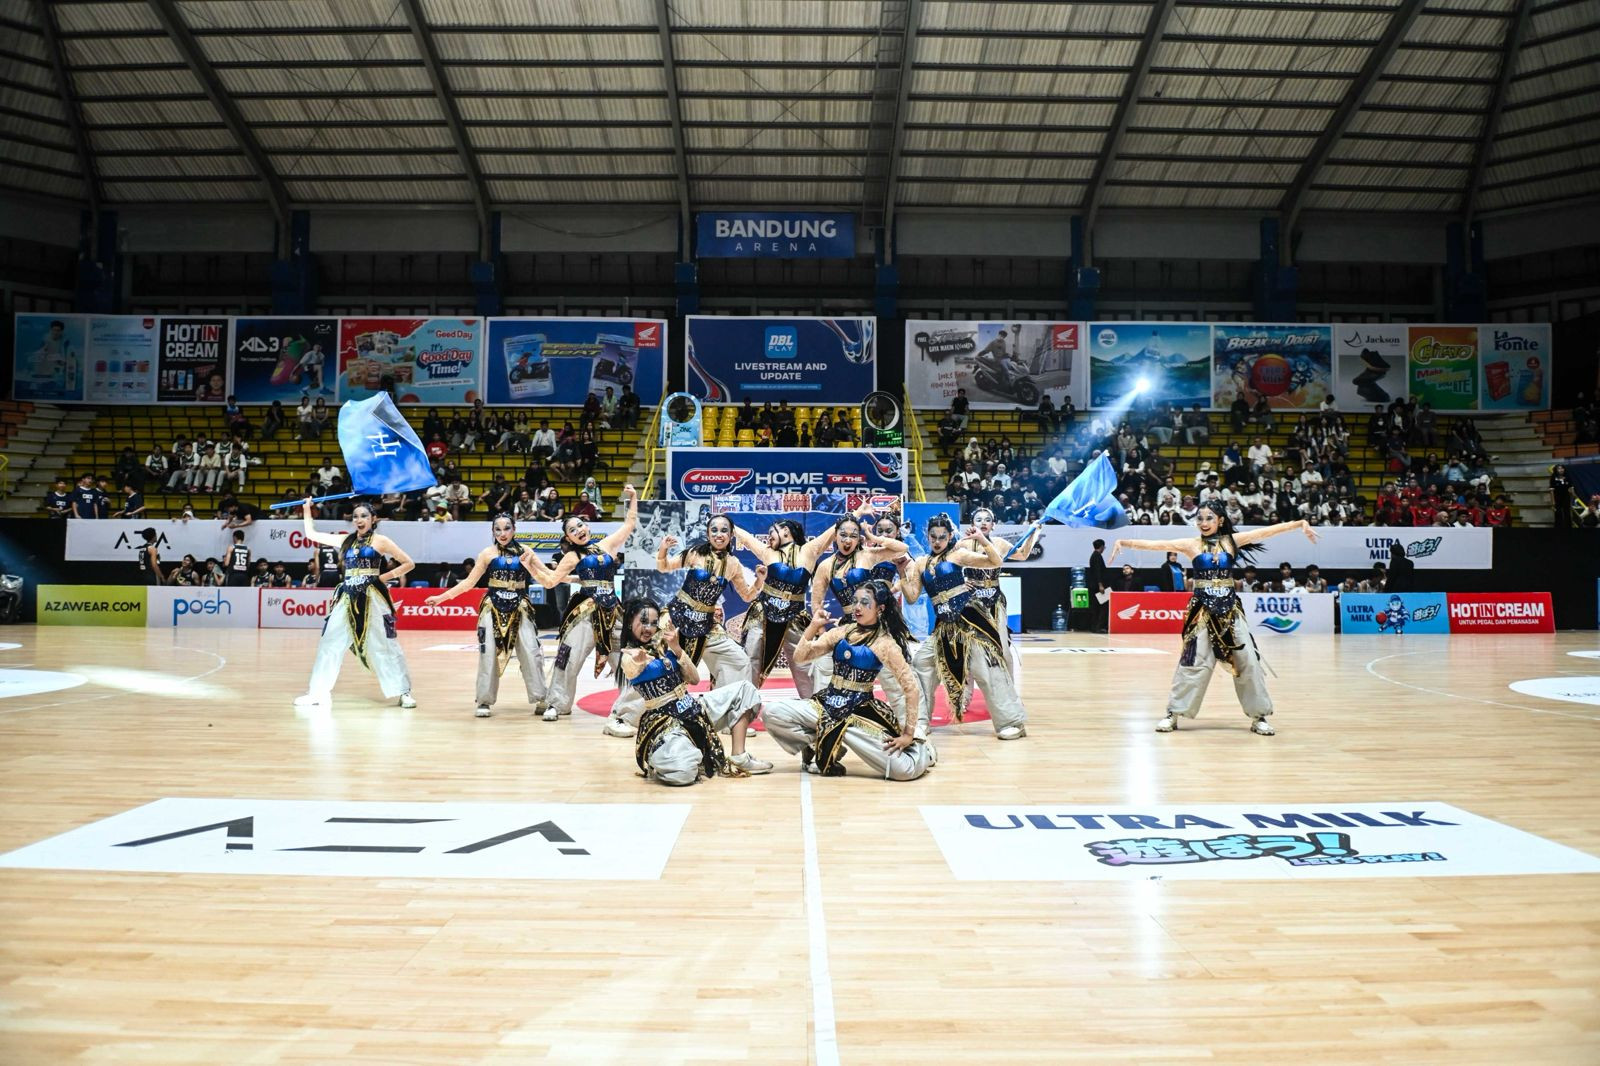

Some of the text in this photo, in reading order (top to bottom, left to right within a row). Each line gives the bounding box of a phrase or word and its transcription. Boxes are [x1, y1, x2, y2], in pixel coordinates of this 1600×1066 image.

[716, 219, 837, 238] BANDUNG
[735, 242, 817, 252] ARENA
[167, 325, 202, 341] HOT
[202, 325, 219, 341] IN
[435, 330, 456, 338] Good
[457, 330, 473, 340] Day
[1494, 331, 1509, 340] La
[769, 335, 794, 346] DBL
[1227, 337, 1268, 350] BREAK
[1285, 335, 1320, 346] DOUBT
[1365, 335, 1400, 344] Jackson
[1494, 337, 1539, 351] Fonte
[165, 344, 219, 358] CREAM
[431, 343, 442, 351] It's
[420, 349, 473, 363] Good Day
[431, 361, 461, 375] Time!
[735, 363, 828, 371] LIVESTREAM AND
[760, 372, 802, 380] UPDATE
[755, 472, 823, 484] HOME
[699, 484, 718, 493] DBL
[1366, 538, 1401, 548] ULTRA
[327, 552, 334, 564] 3
[1369, 549, 1391, 560] MIL
[44, 601, 141, 612] AZAWEAR.COM
[173, 588, 231, 627] posh
[282, 598, 327, 617] Good
[402, 604, 479, 617] HONDA
[1253, 596, 1303, 616] AQUA
[1346, 605, 1375, 614] ULTRA
[1451, 602, 1545, 618] HOT IN CREAM
[1140, 609, 1189, 620] HON
[1350, 614, 1372, 622] MILK
[962, 810, 1462, 831] ULTRA MILK
